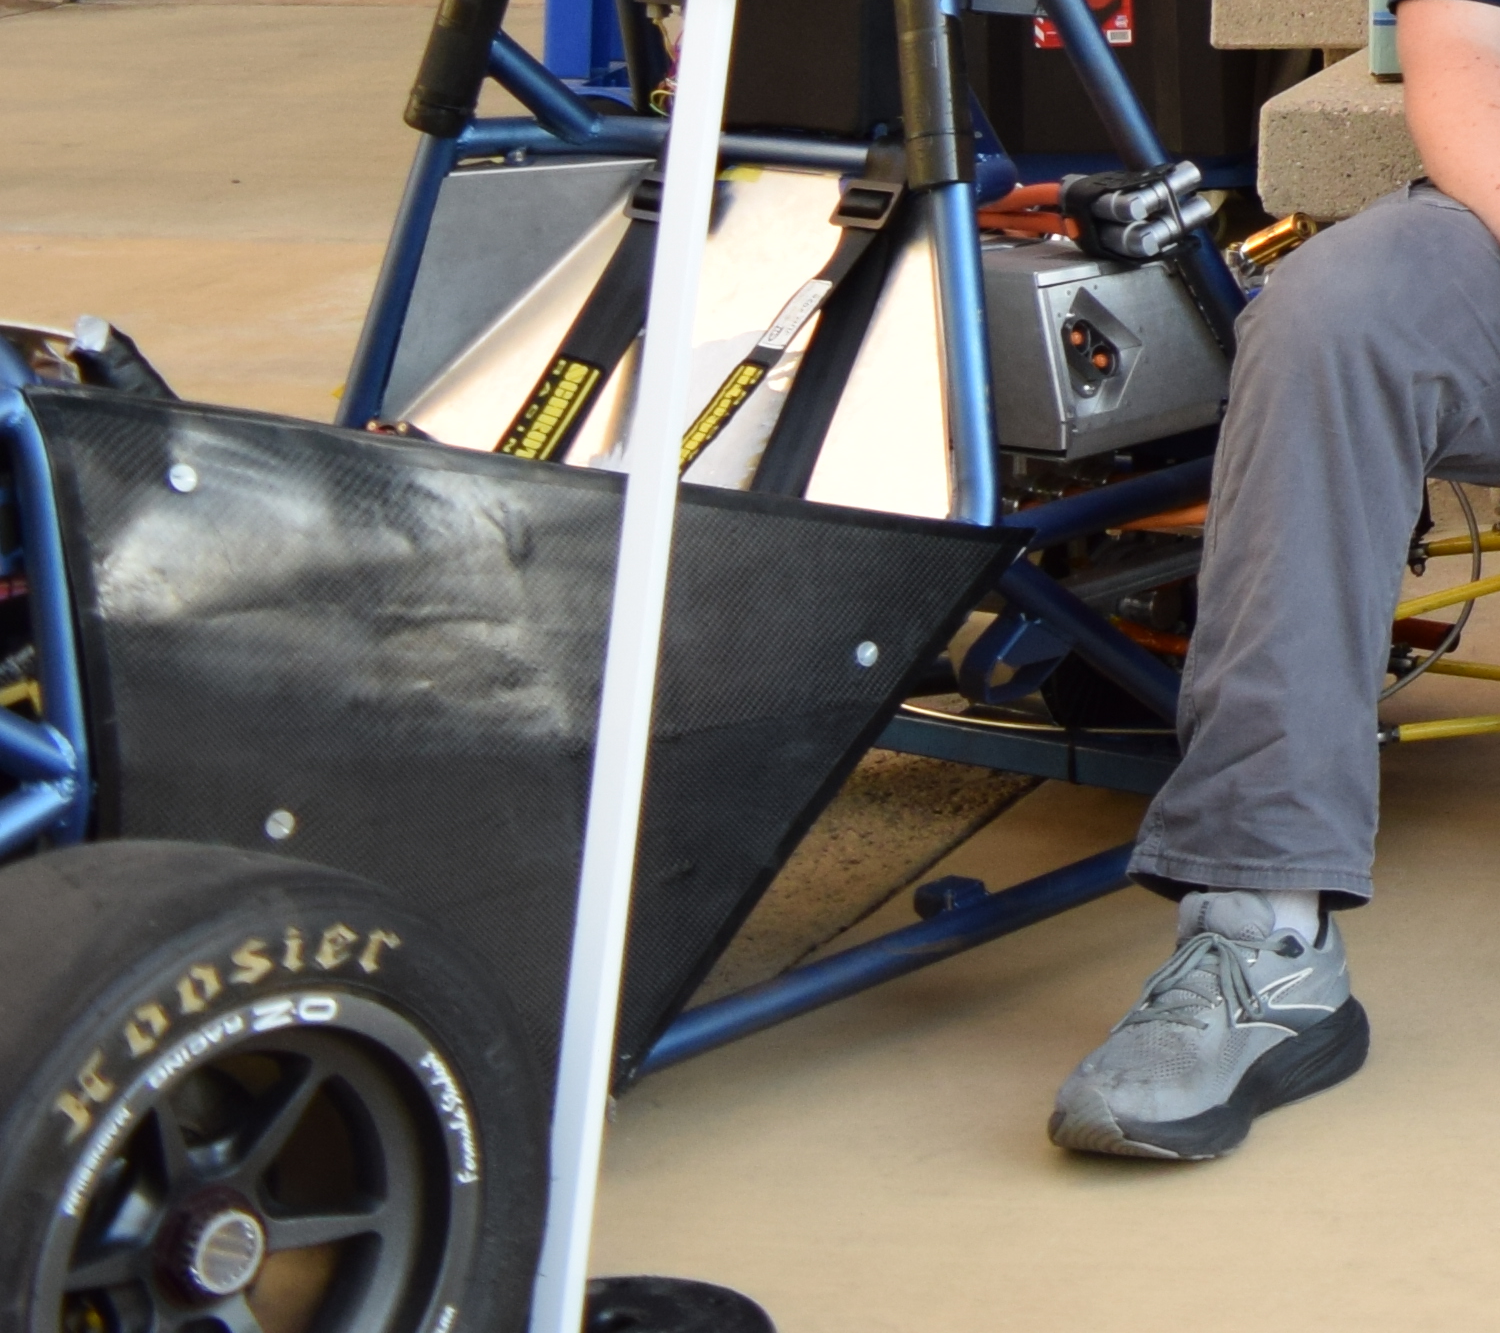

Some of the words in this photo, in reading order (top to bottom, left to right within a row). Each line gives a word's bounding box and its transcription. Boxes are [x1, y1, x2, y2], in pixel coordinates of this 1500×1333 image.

[502, 359, 567, 453] RACIN
[55, 921, 401, 1144] Hoosier
[149, 1015, 244, 1089] RACING
